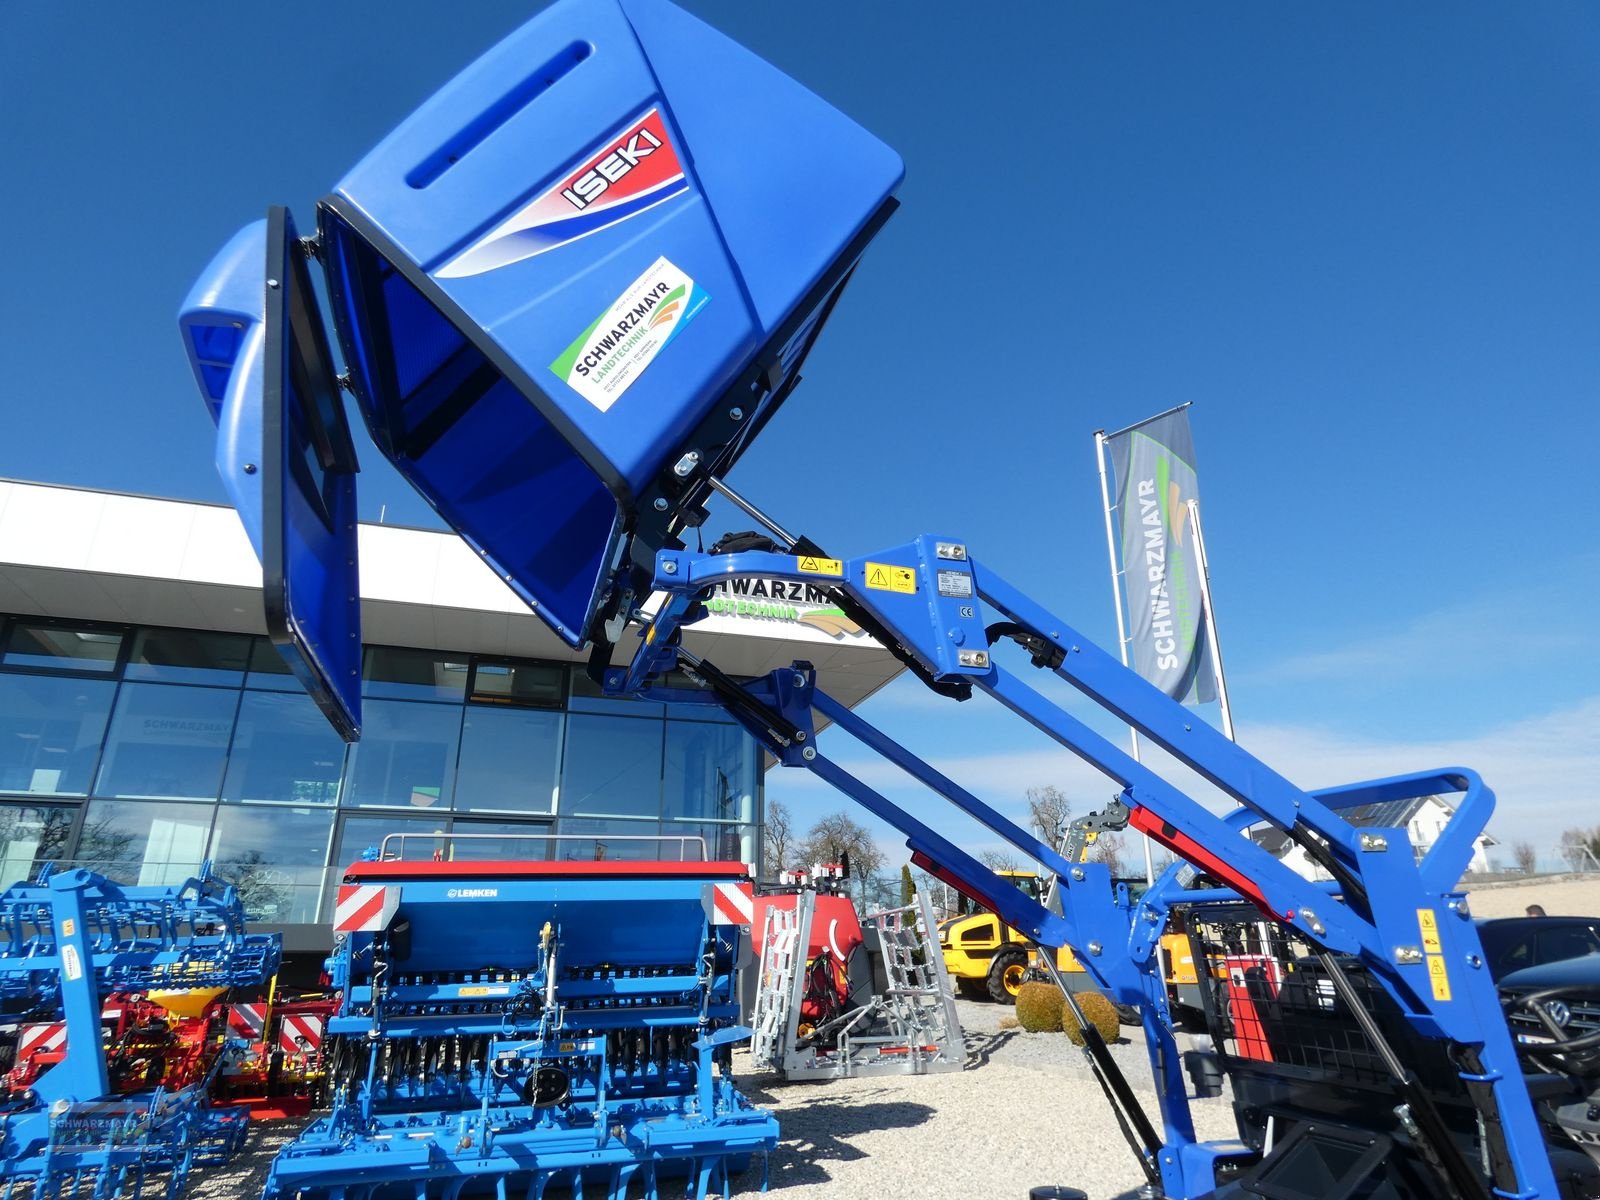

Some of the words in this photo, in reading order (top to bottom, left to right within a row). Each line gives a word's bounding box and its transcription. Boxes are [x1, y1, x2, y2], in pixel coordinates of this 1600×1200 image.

[561, 127, 664, 211] ISEKI
[575, 281, 671, 378] SCHWARZMAYR
[591, 325, 649, 384] LANDTECHNIK
[1138, 478, 1178, 671] SCHWARZMAYR
[143, 719, 230, 732] SCHWARZMAY
[457, 889, 498, 898] LEMKEN
